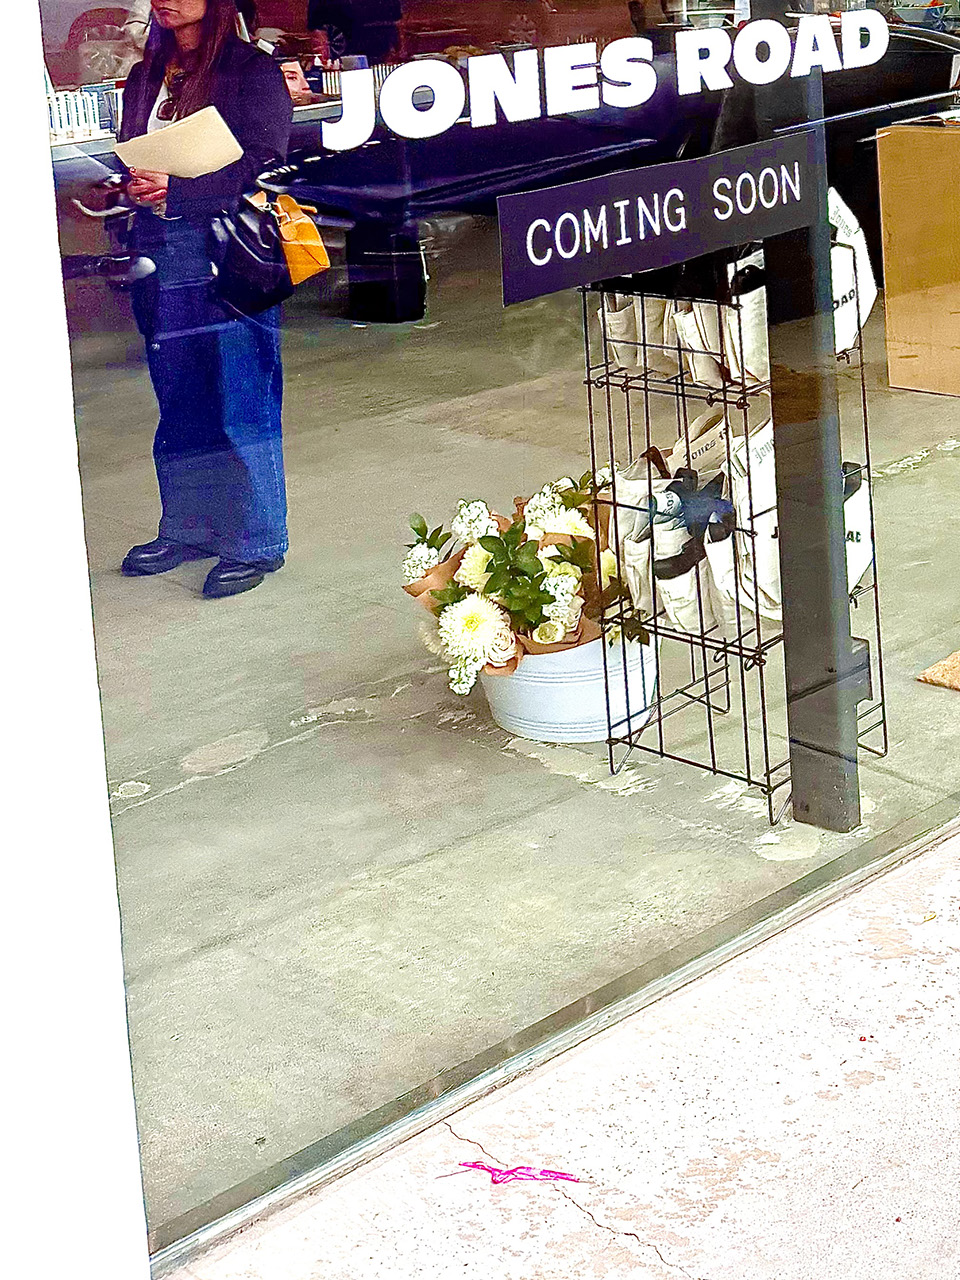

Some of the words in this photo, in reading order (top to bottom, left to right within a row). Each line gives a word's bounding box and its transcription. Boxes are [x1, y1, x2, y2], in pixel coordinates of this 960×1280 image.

[322, 37, 659, 150] JONES
[674, 8, 890, 95] ROAD
[526, 187, 687, 267] COMING
[714, 160, 801, 220] SOON
